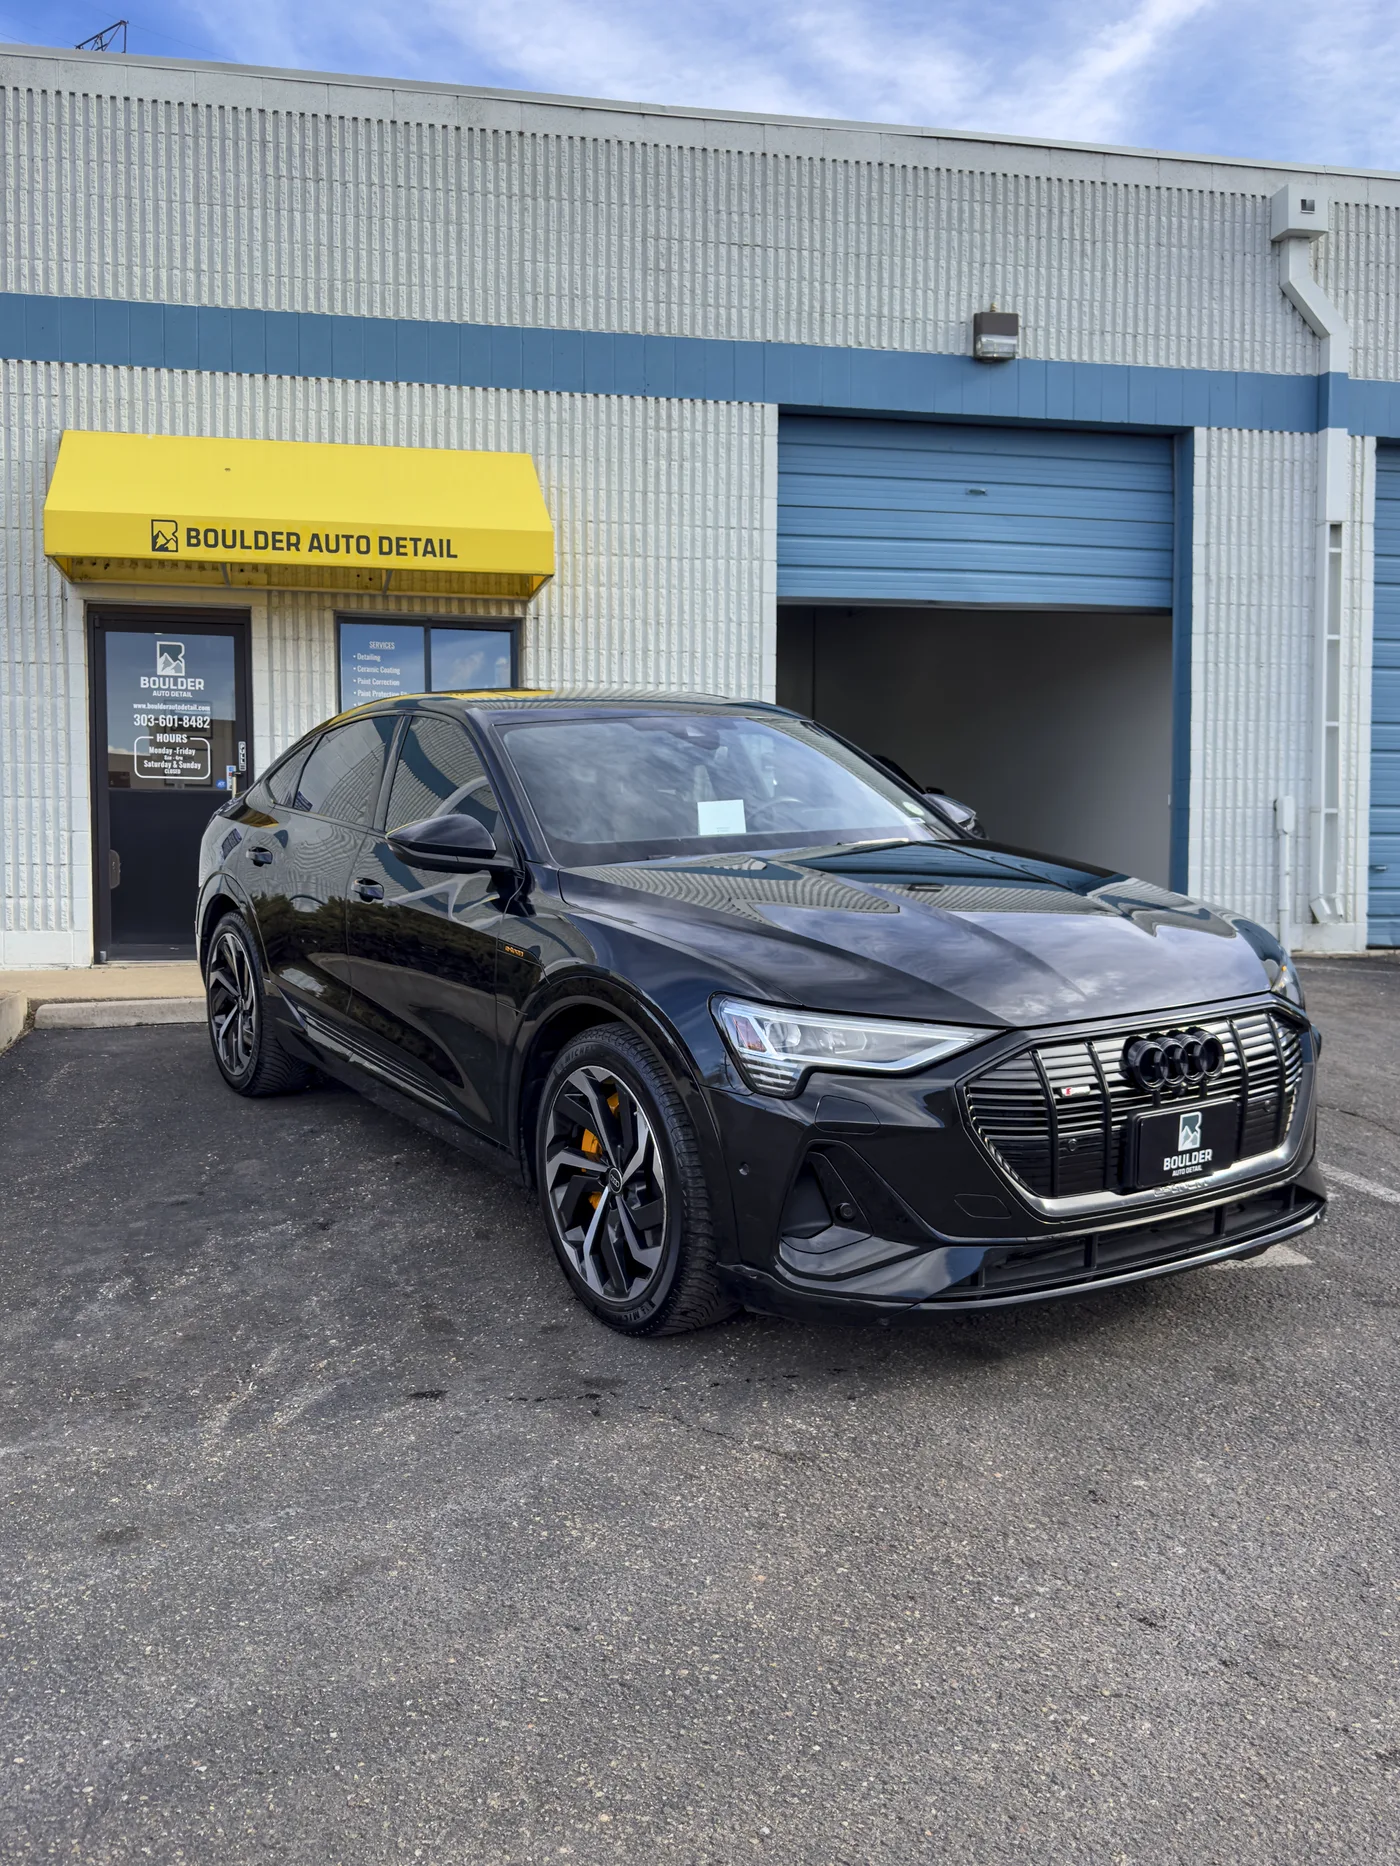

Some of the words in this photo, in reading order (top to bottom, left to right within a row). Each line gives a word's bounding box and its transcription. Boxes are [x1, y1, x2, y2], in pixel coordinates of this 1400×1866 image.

[186, 527, 301, 552] BOULDER
[308, 532, 371, 555] AUTO
[378, 535, 458, 559] DETAIL
[369, 641, 395, 650] SERVICES
[356, 653, 381, 662] Detailing
[357, 665, 379, 673] Ceramic
[380, 666, 400, 675] Coating
[140, 676, 204, 691] BOULDER
[372, 678, 400, 686] Correction
[357, 690, 371, 698] Paint
[133, 702, 211, 711] www.boulderautodetail.com
[133, 714, 211, 729] 303-601-8482
[156, 733, 188, 743] HOURS
[149, 746, 173, 755] Monday
[143, 760, 171, 769] Saturday
[178, 761, 201, 770] Sunday
[1163, 1149, 1213, 1171] BOULDER
[1172, 1168, 1185, 1177] AUTO
[1186, 1164, 1203, 1174] DETAIL
